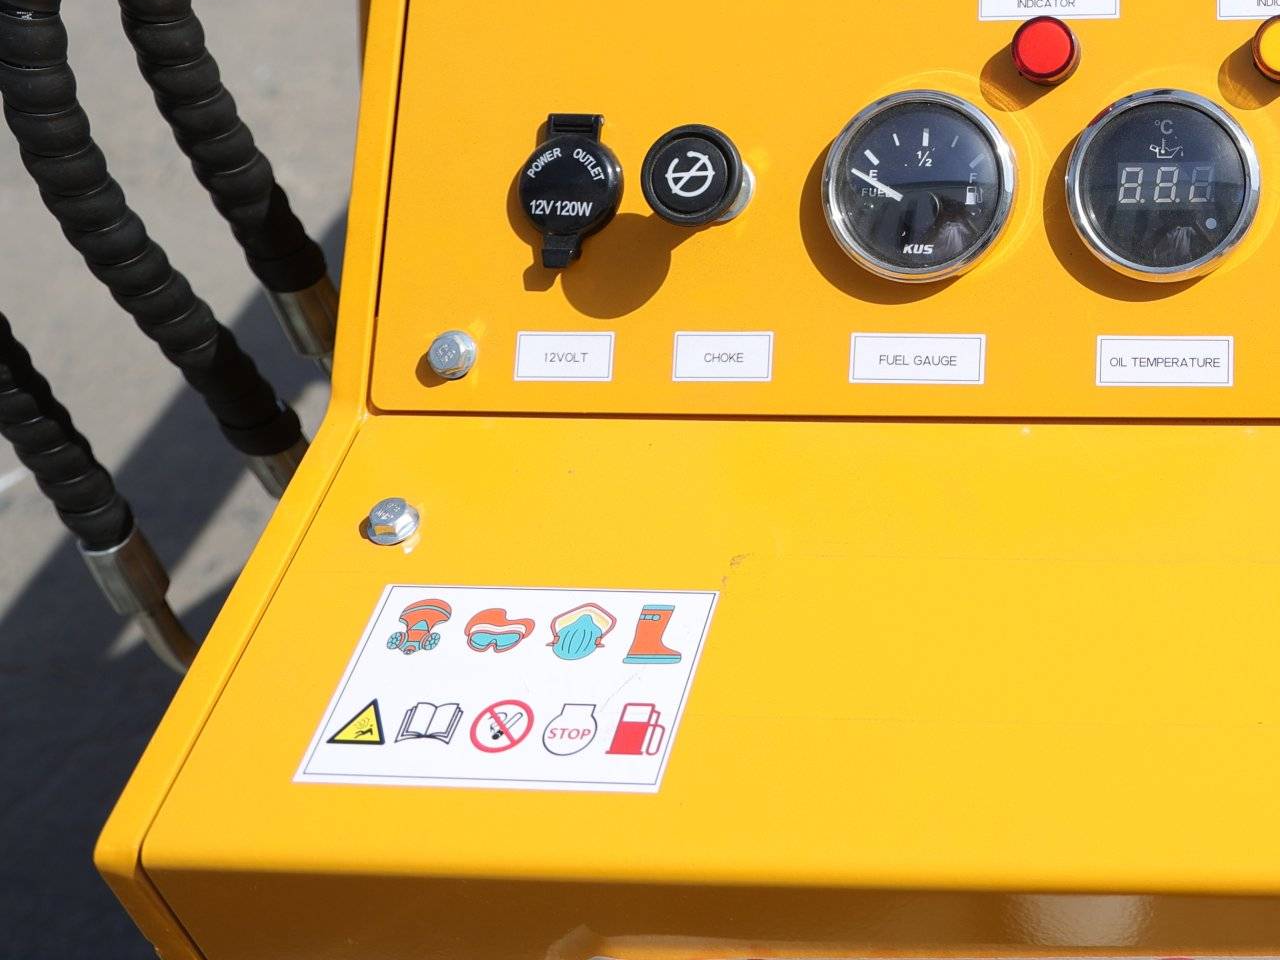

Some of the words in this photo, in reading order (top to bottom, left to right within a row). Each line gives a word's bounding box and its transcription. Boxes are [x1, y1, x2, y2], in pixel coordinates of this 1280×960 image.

[526, 147, 563, 179] POWER
[572, 148, 605, 182] OUTLET
[969, 172, 978, 184] F
[529, 199, 552, 215] 12V
[555, 201, 593, 217] 120W
[902, 243, 934, 254] KUS
[543, 352, 589, 363] 12VOLT
[703, 352, 745, 363] CHOKE
[878, 354, 909, 367] FUEL
[913, 354, 959, 367] GAUGE
[1109, 357, 1129, 369] OIL
[1131, 357, 1222, 370] TEMPERATURE
[547, 727, 592, 741] STOP
